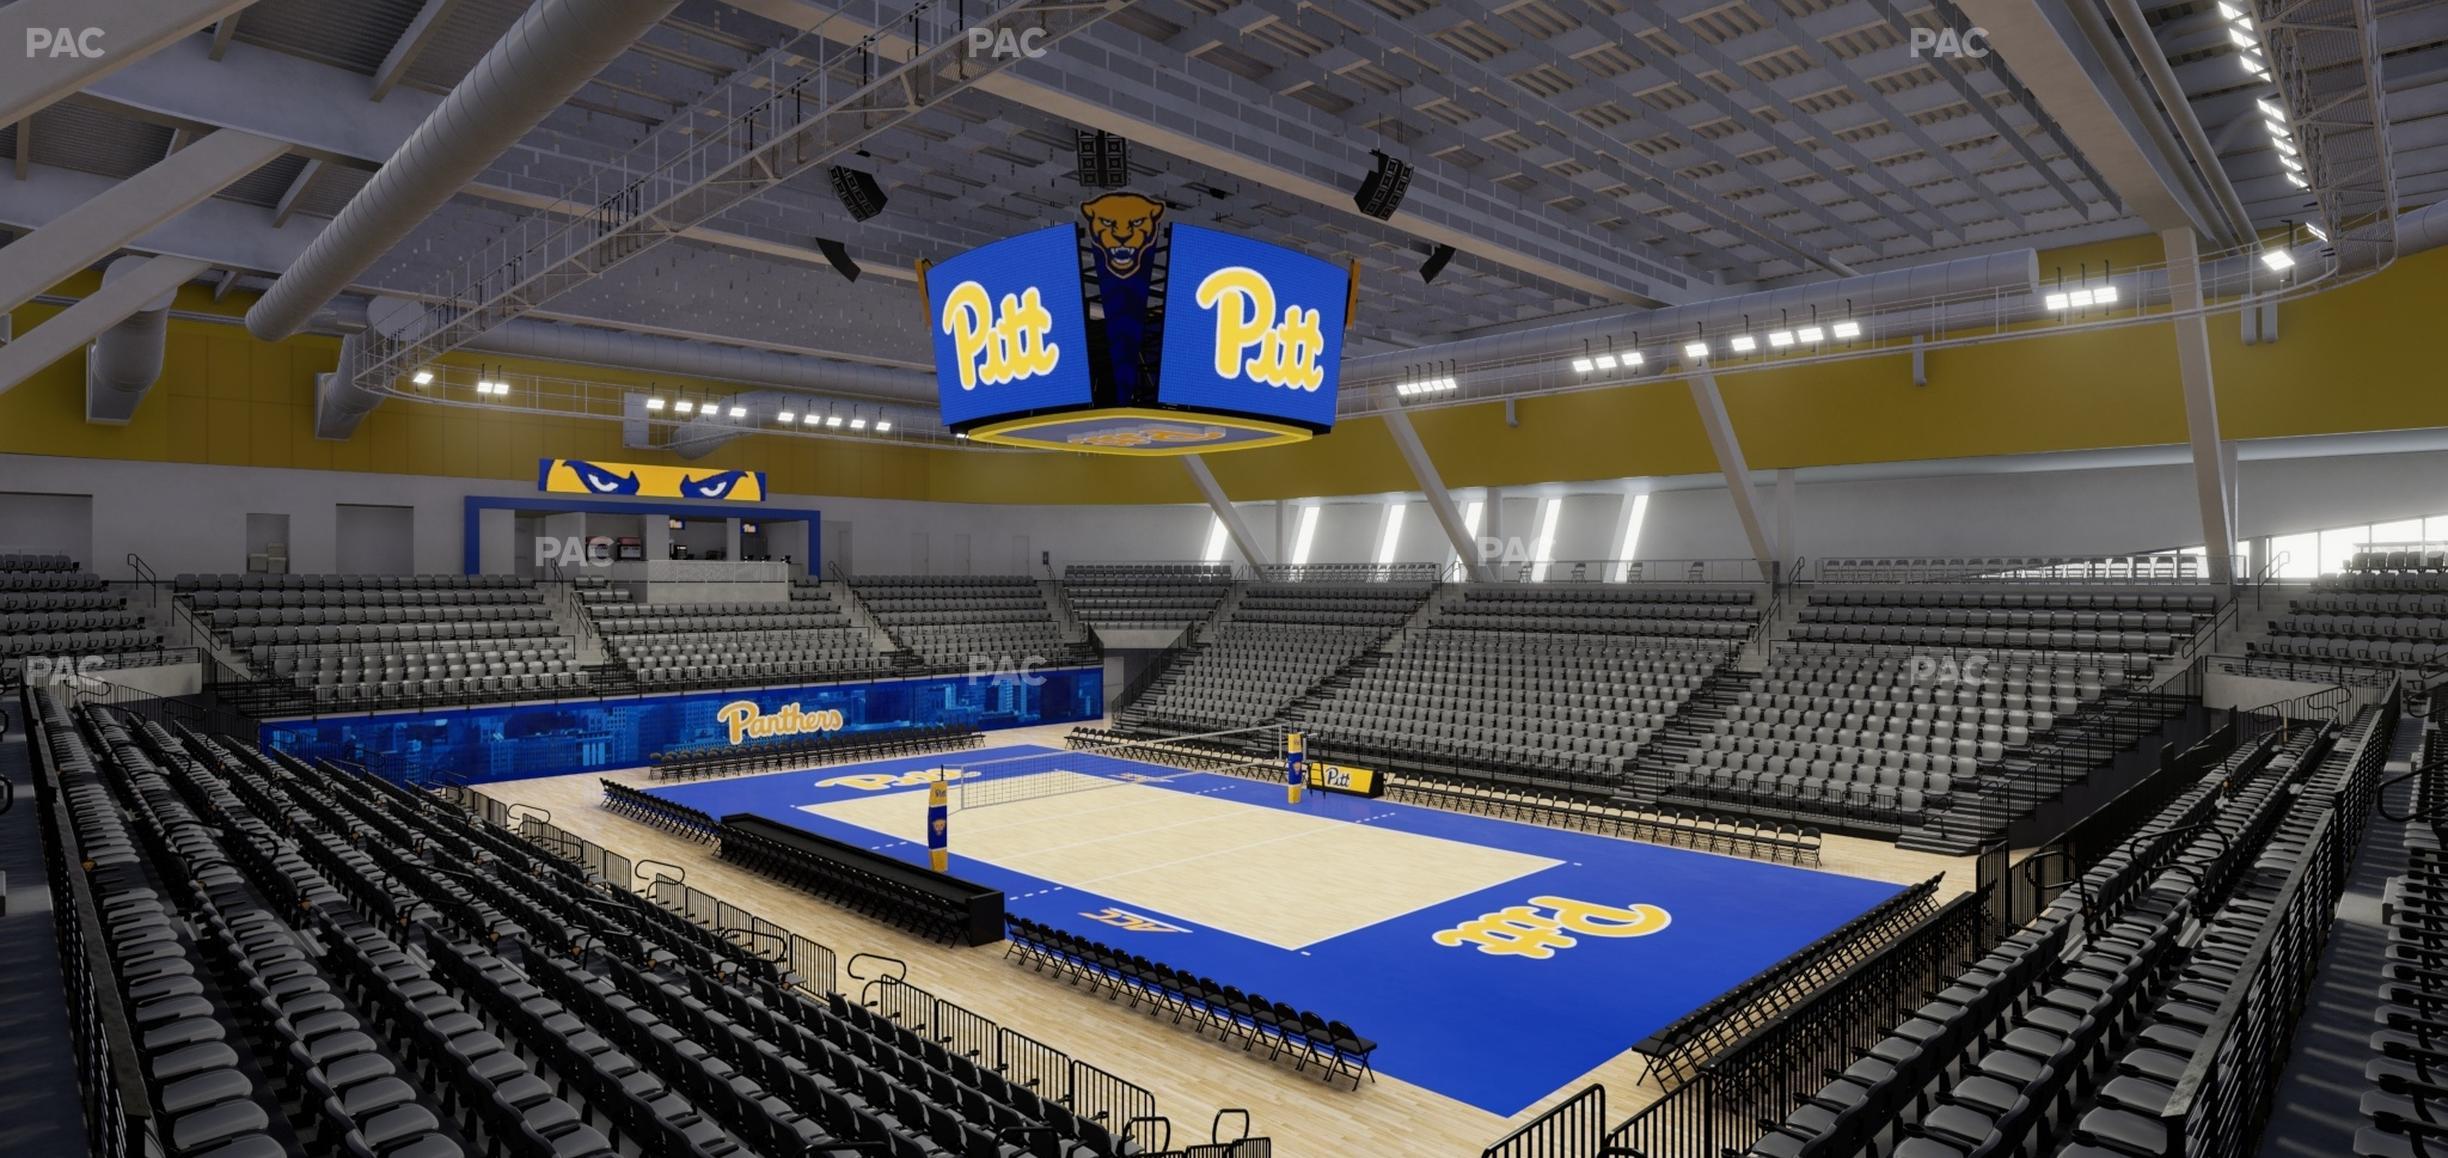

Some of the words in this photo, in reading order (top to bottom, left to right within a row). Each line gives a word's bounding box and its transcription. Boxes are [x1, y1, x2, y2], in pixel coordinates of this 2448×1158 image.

[942, 281, 1060, 391] Pitt
[1196, 267, 1324, 392] Pitt
[717, 700, 843, 745] Panthers
[1325, 766, 1351, 788] Pitt
[1432, 895, 1672, 959] Pitt
